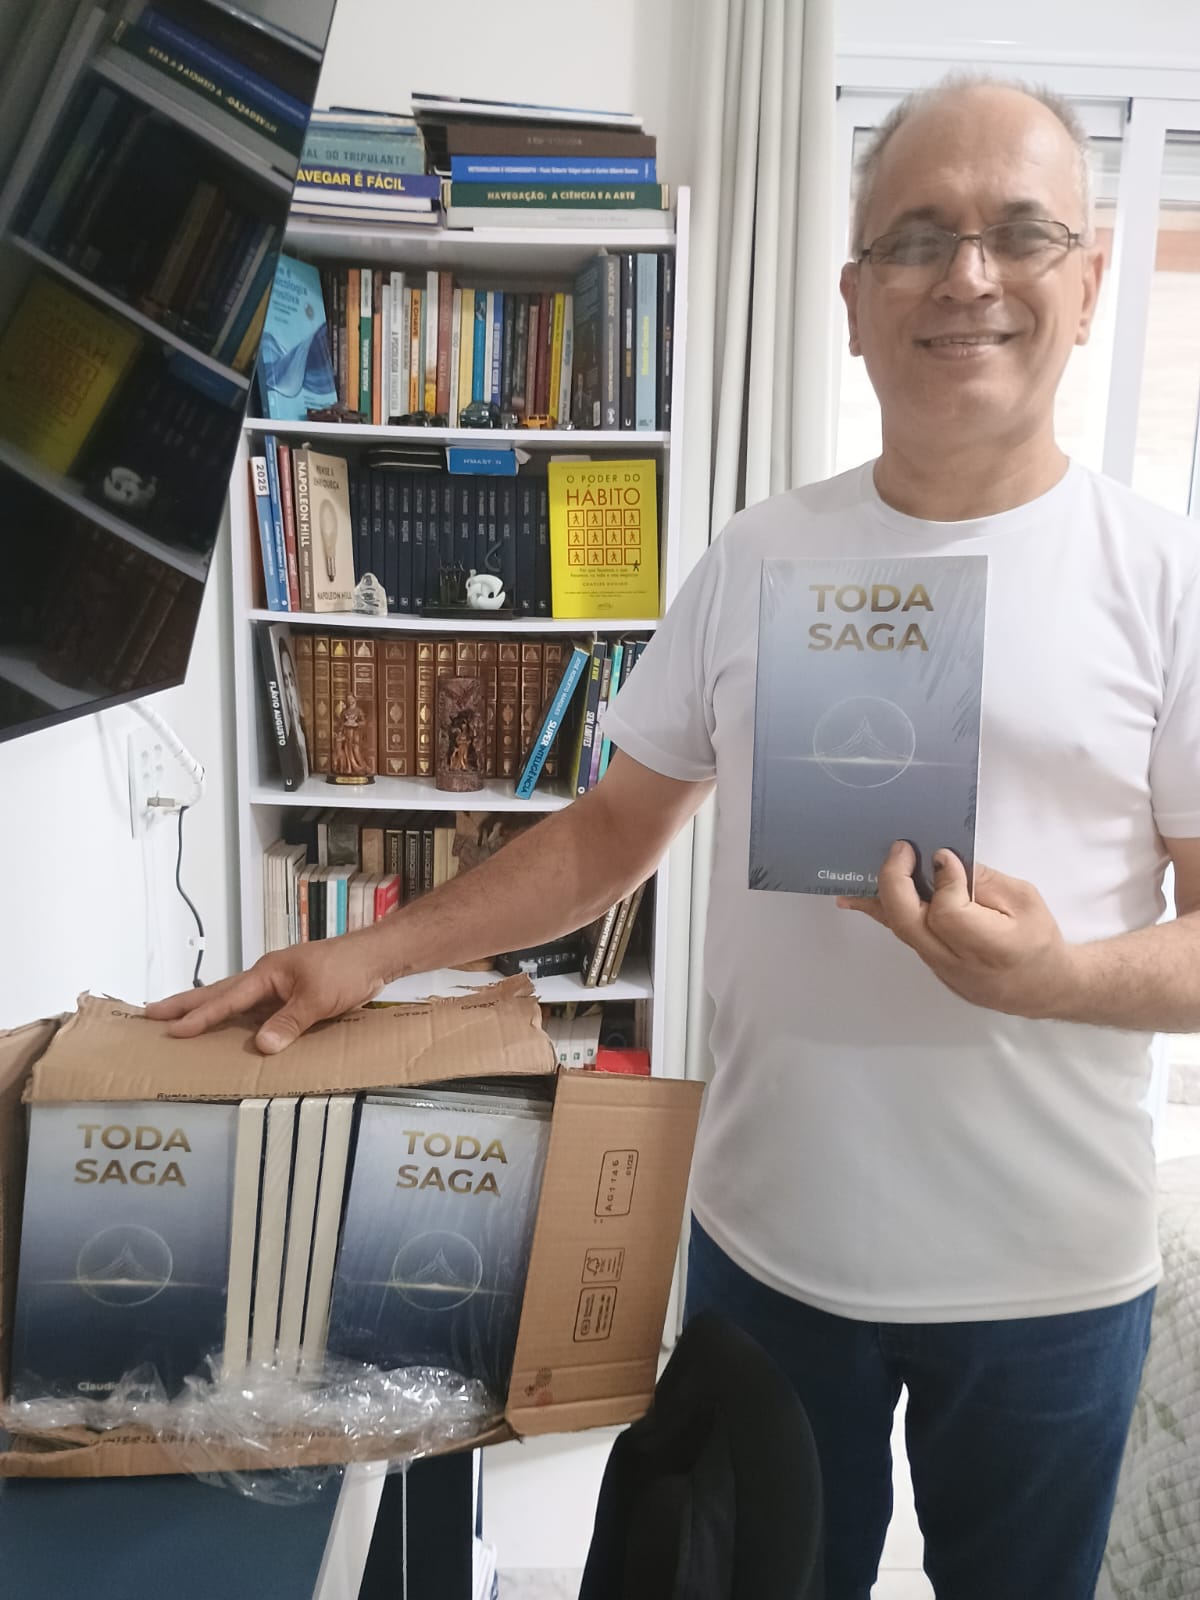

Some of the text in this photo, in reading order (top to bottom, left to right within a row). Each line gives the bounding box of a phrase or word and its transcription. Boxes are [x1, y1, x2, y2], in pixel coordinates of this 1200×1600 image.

[344, 151, 406, 166] TRIPULANTE
[296, 168, 405, 191] AVEGAR É FÁCIL
[552, 191, 558, 200] A
[560, 190, 597, 200] CIÊNCIA
[605, 191, 612, 200] A
[613, 191, 636, 200] ARTE
[255, 464, 267, 492] 2025
[298, 461, 310, 522] NAPOLEON
[566, 473, 641, 484] O PODER DO
[566, 484, 641, 506] HÁBITO
[300, 524, 310, 547] HILL
[809, 583, 934, 612] TODA
[807, 623, 929, 652] SAGA
[269, 681, 286, 746] FLÁVIO AUGUSTO
[586, 710, 595, 725] SEM
[817, 870, 864, 882] Claudio
[591, 947, 604, 977] Mindset
[76, 1124, 192, 1153] TODA
[401, 1129, 508, 1165] TODA
[74, 1159, 187, 1187] SAGA
[396, 1164, 501, 1198] SAGA
